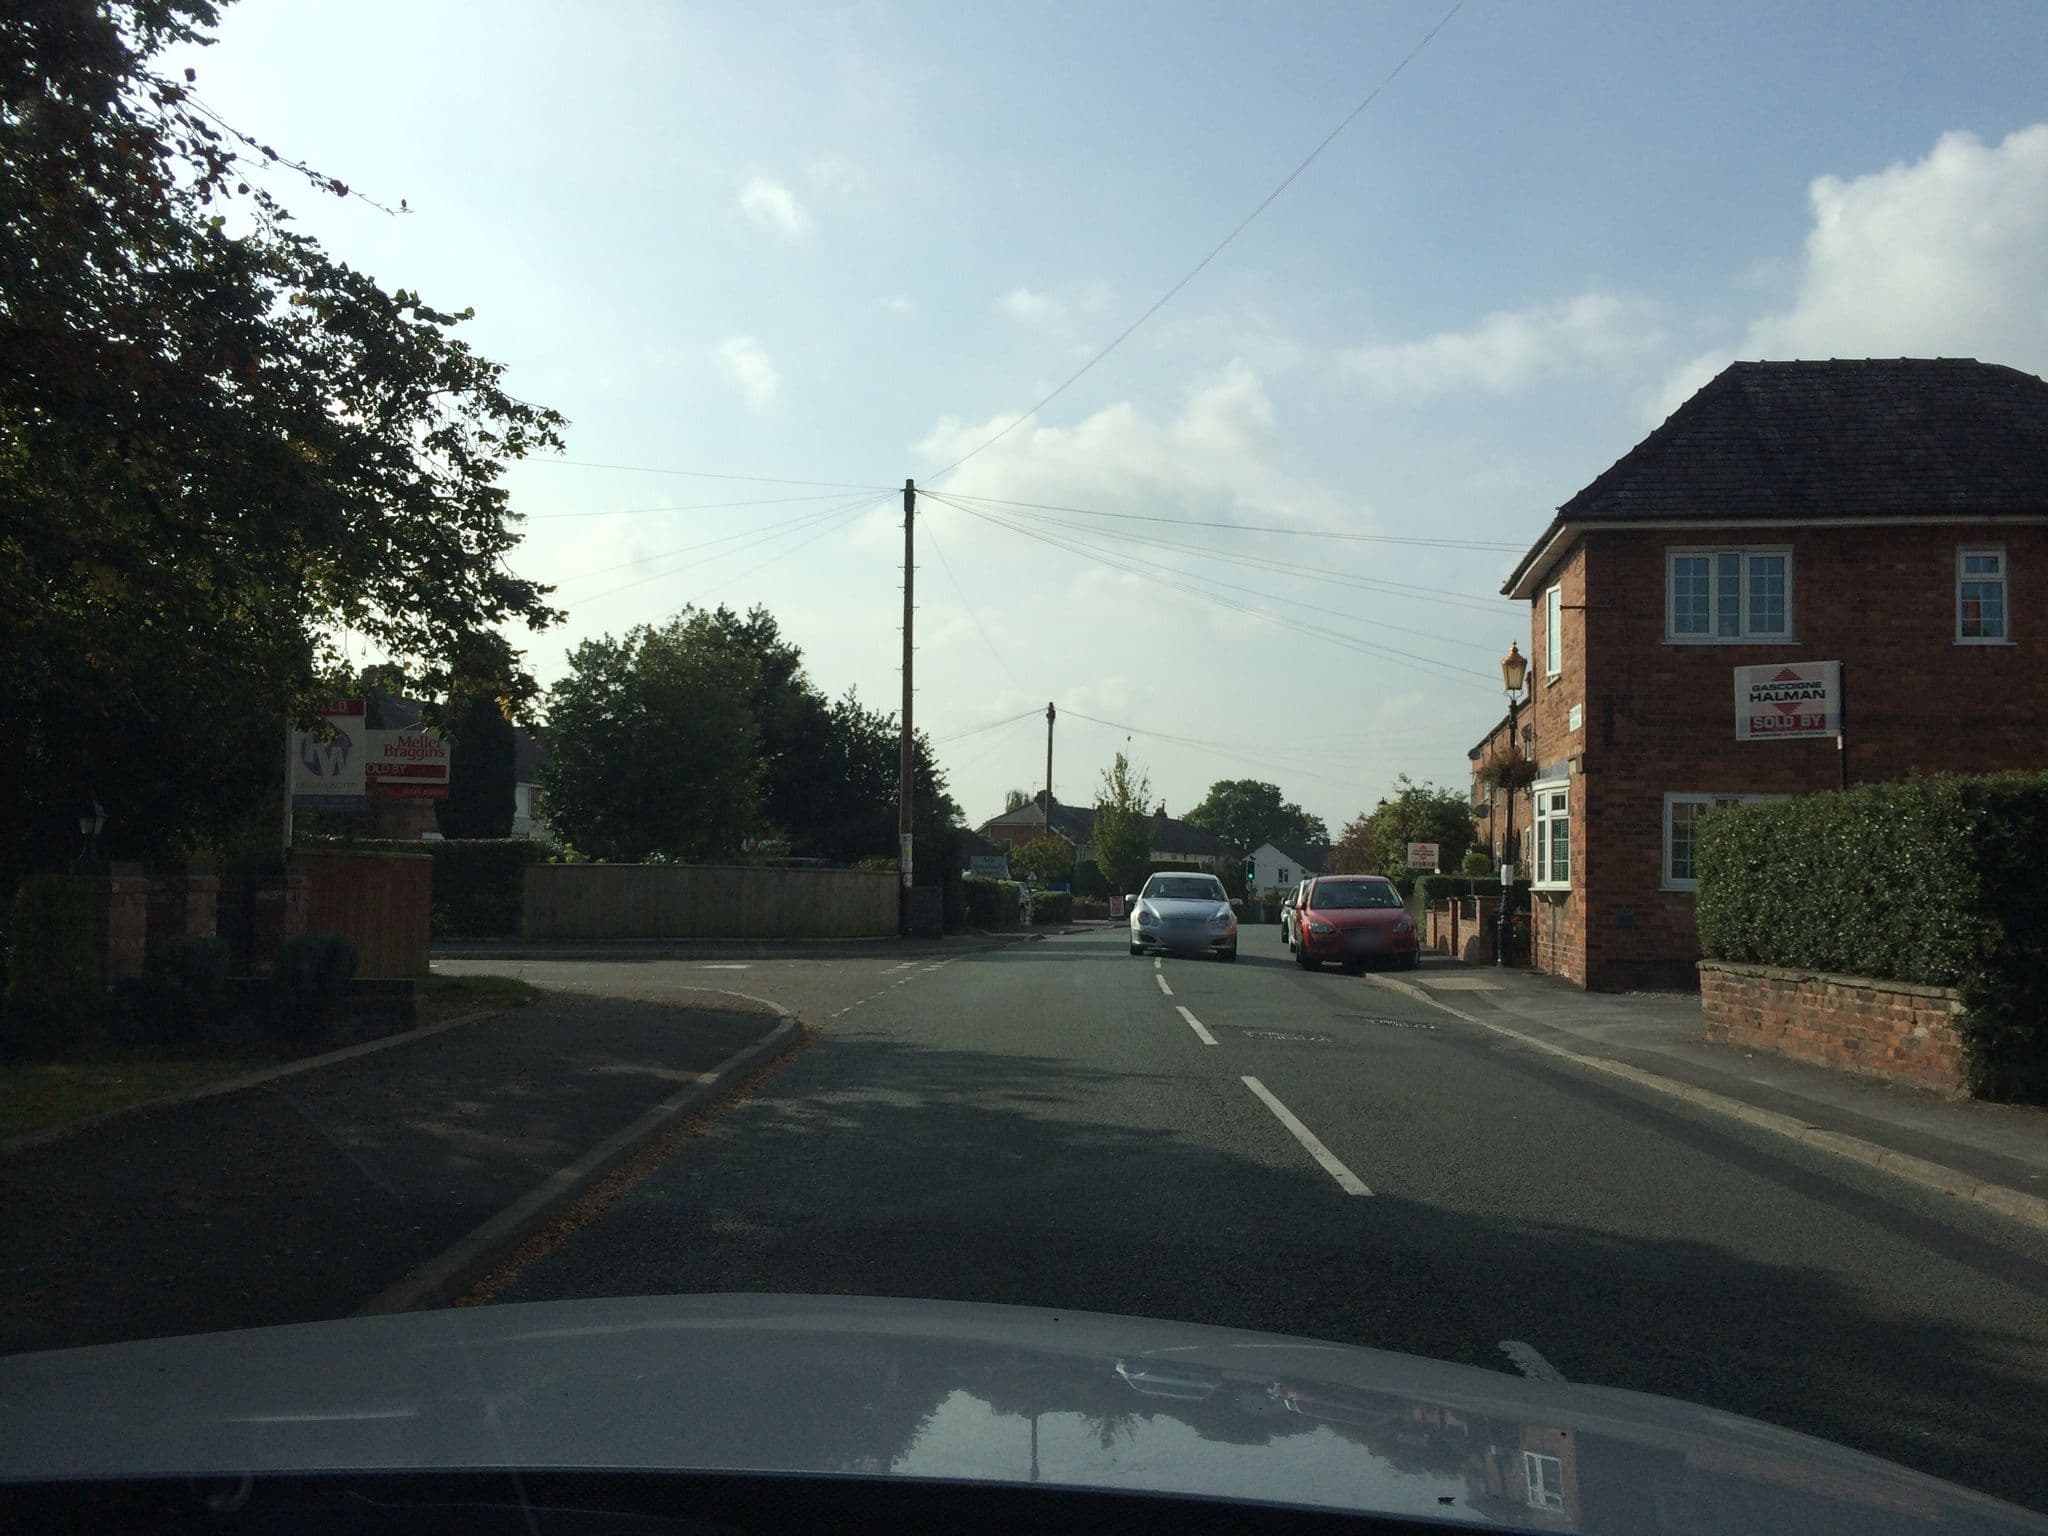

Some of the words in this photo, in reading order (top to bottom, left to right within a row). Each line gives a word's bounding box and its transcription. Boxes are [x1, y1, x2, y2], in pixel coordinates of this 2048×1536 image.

[1751, 681, 1822, 692] GASCOIGNE
[1749, 690, 1826, 703] HALMAN
[1753, 715, 1793, 729] SOLD
[1801, 714, 1822, 727] BY
[383, 743, 446, 761] Braggins
[367, 763, 390, 774] OLD
[392, 763, 407, 774] BY
